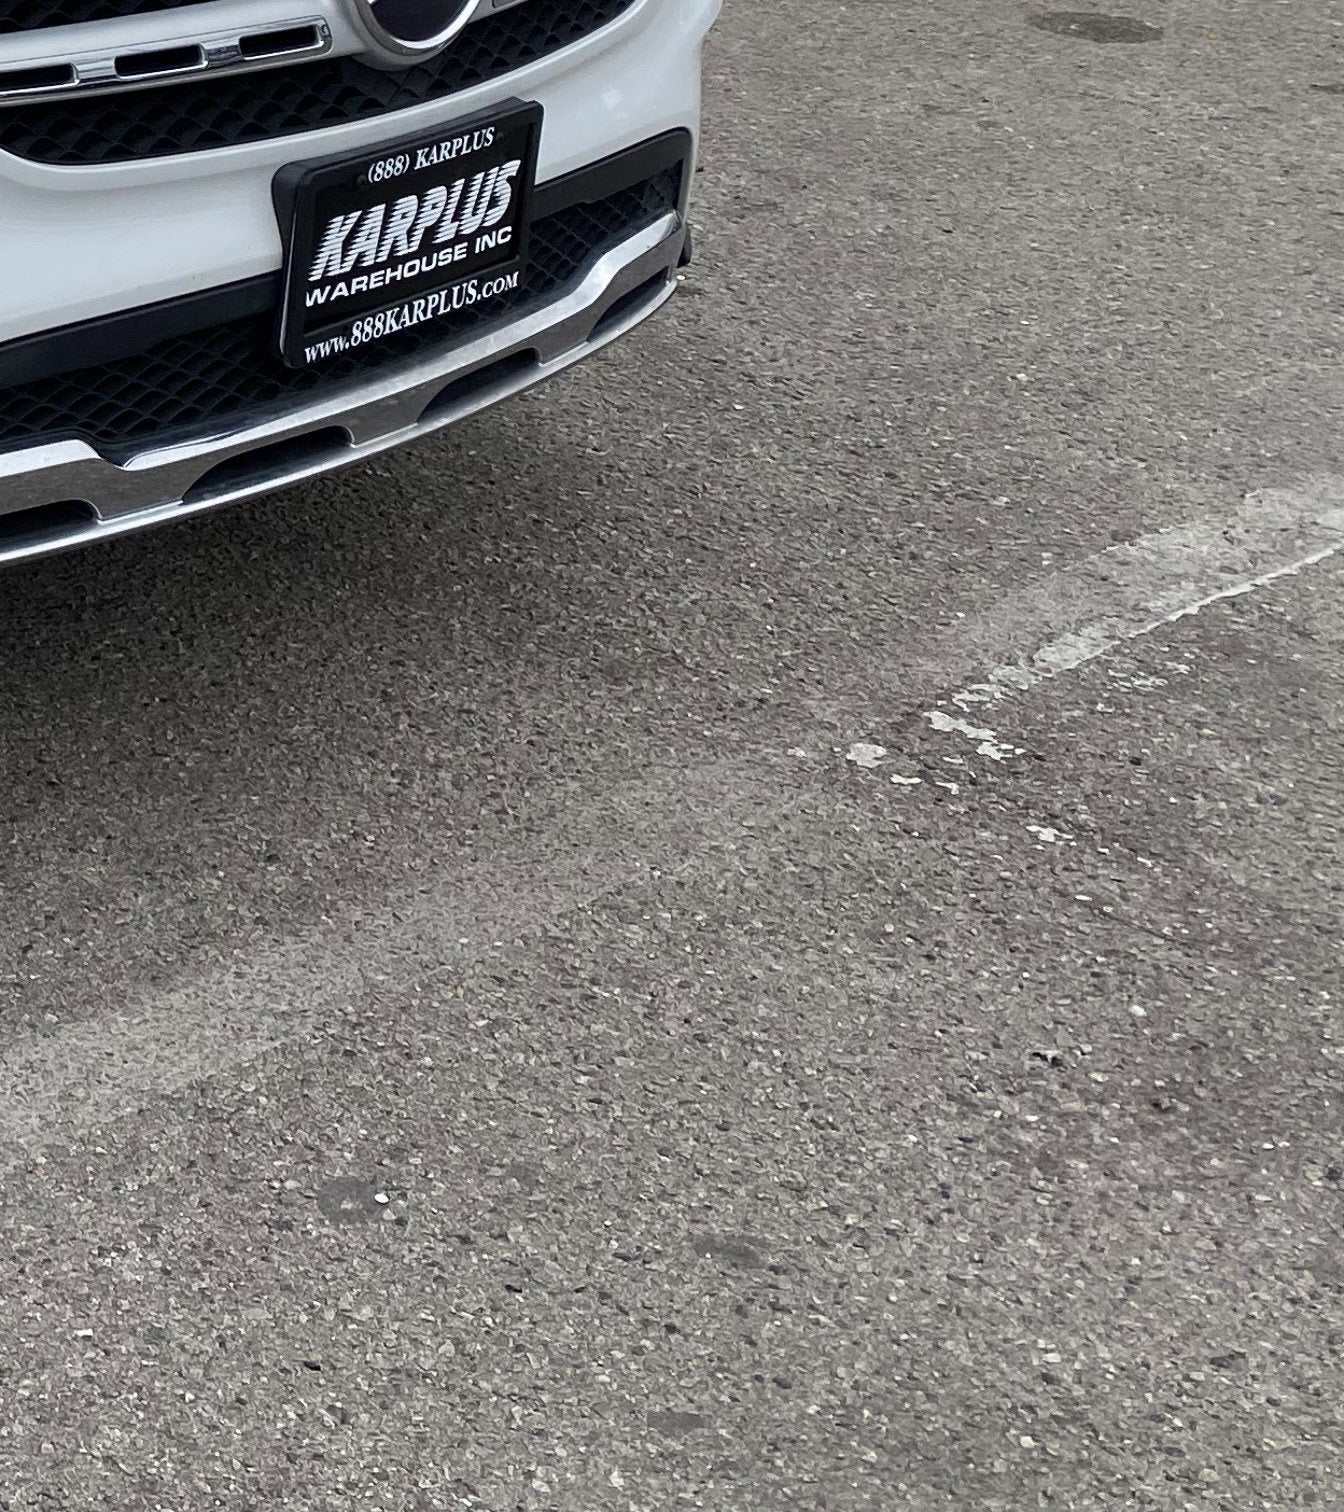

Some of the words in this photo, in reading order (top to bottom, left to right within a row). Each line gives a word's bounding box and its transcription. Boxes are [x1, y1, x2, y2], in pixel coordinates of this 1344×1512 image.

[367, 153, 411, 184] (888)
[414, 126, 496, 171] KARPLUS
[307, 159, 522, 282] KARPLUS
[305, 242, 468, 307] WAREHOUSE
[474, 226, 513, 254] INC
